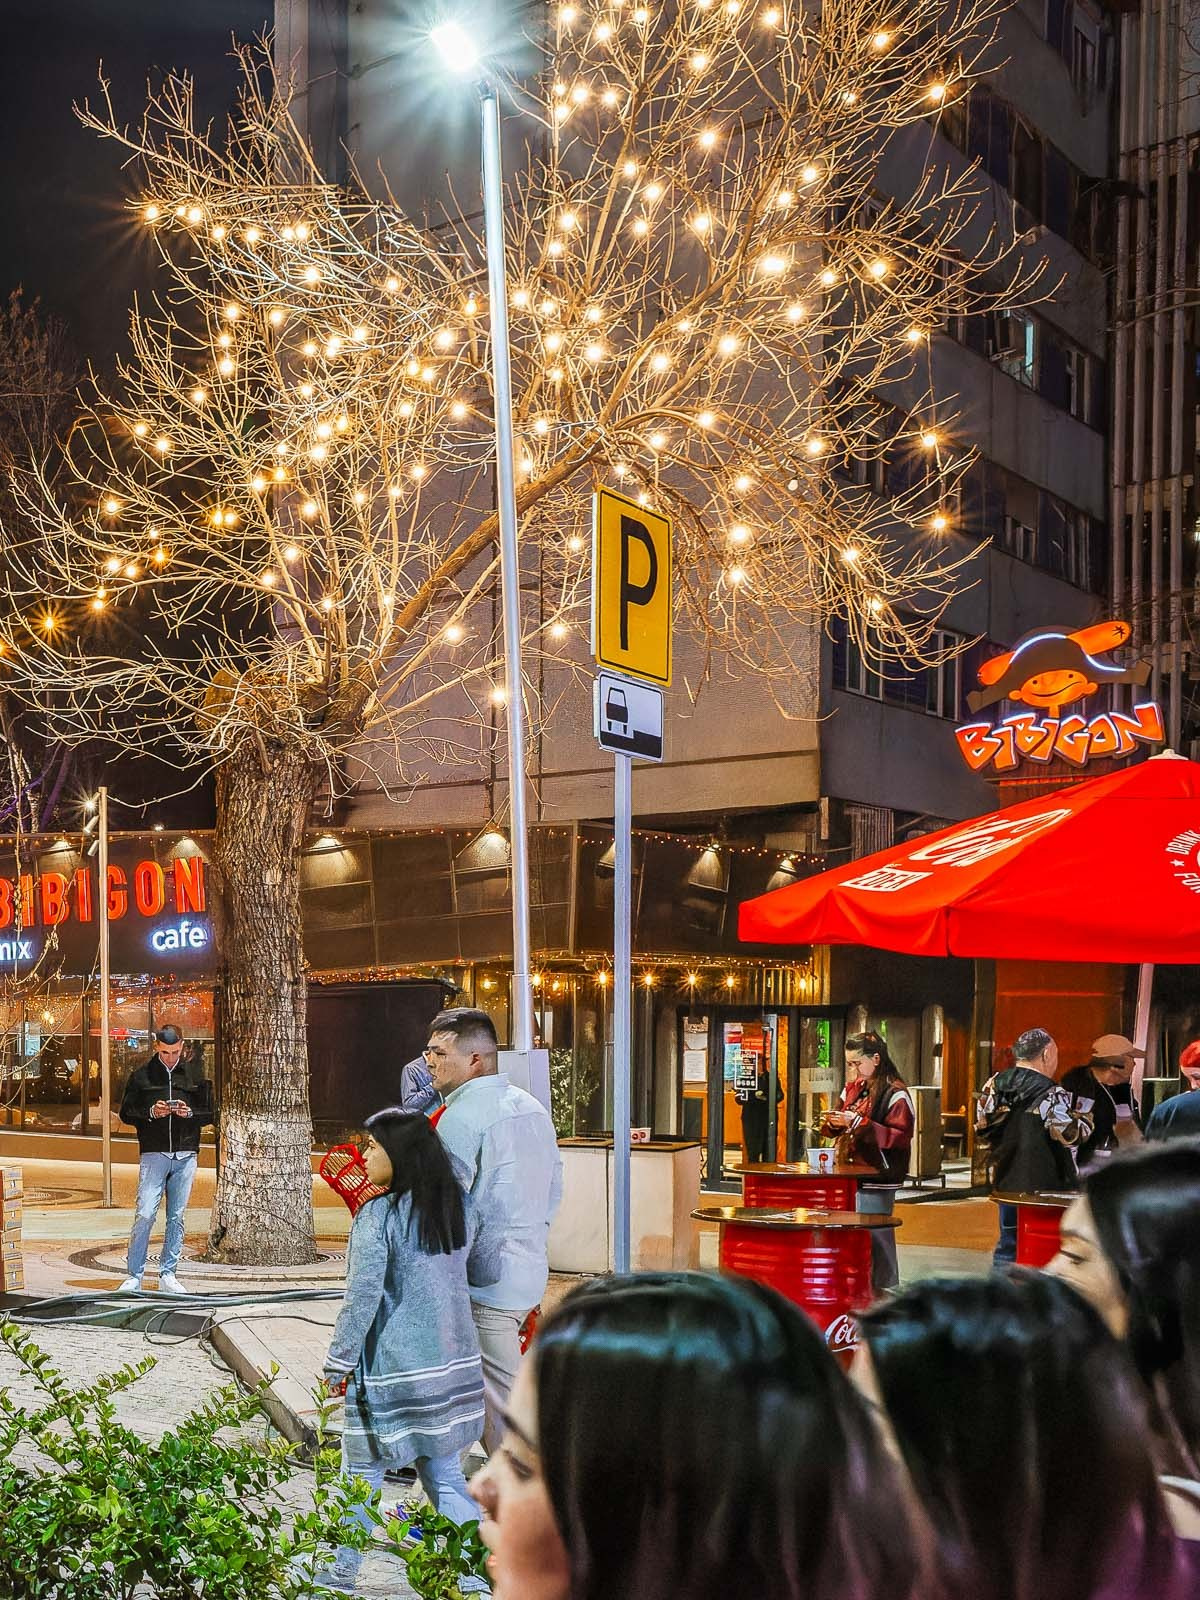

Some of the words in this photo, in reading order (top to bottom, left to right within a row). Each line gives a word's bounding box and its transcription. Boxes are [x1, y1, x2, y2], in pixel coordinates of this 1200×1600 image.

[619, 514, 658, 651] P
[955, 702, 1164, 770] BIBIGON
[152, 920, 208, 951] cafe
